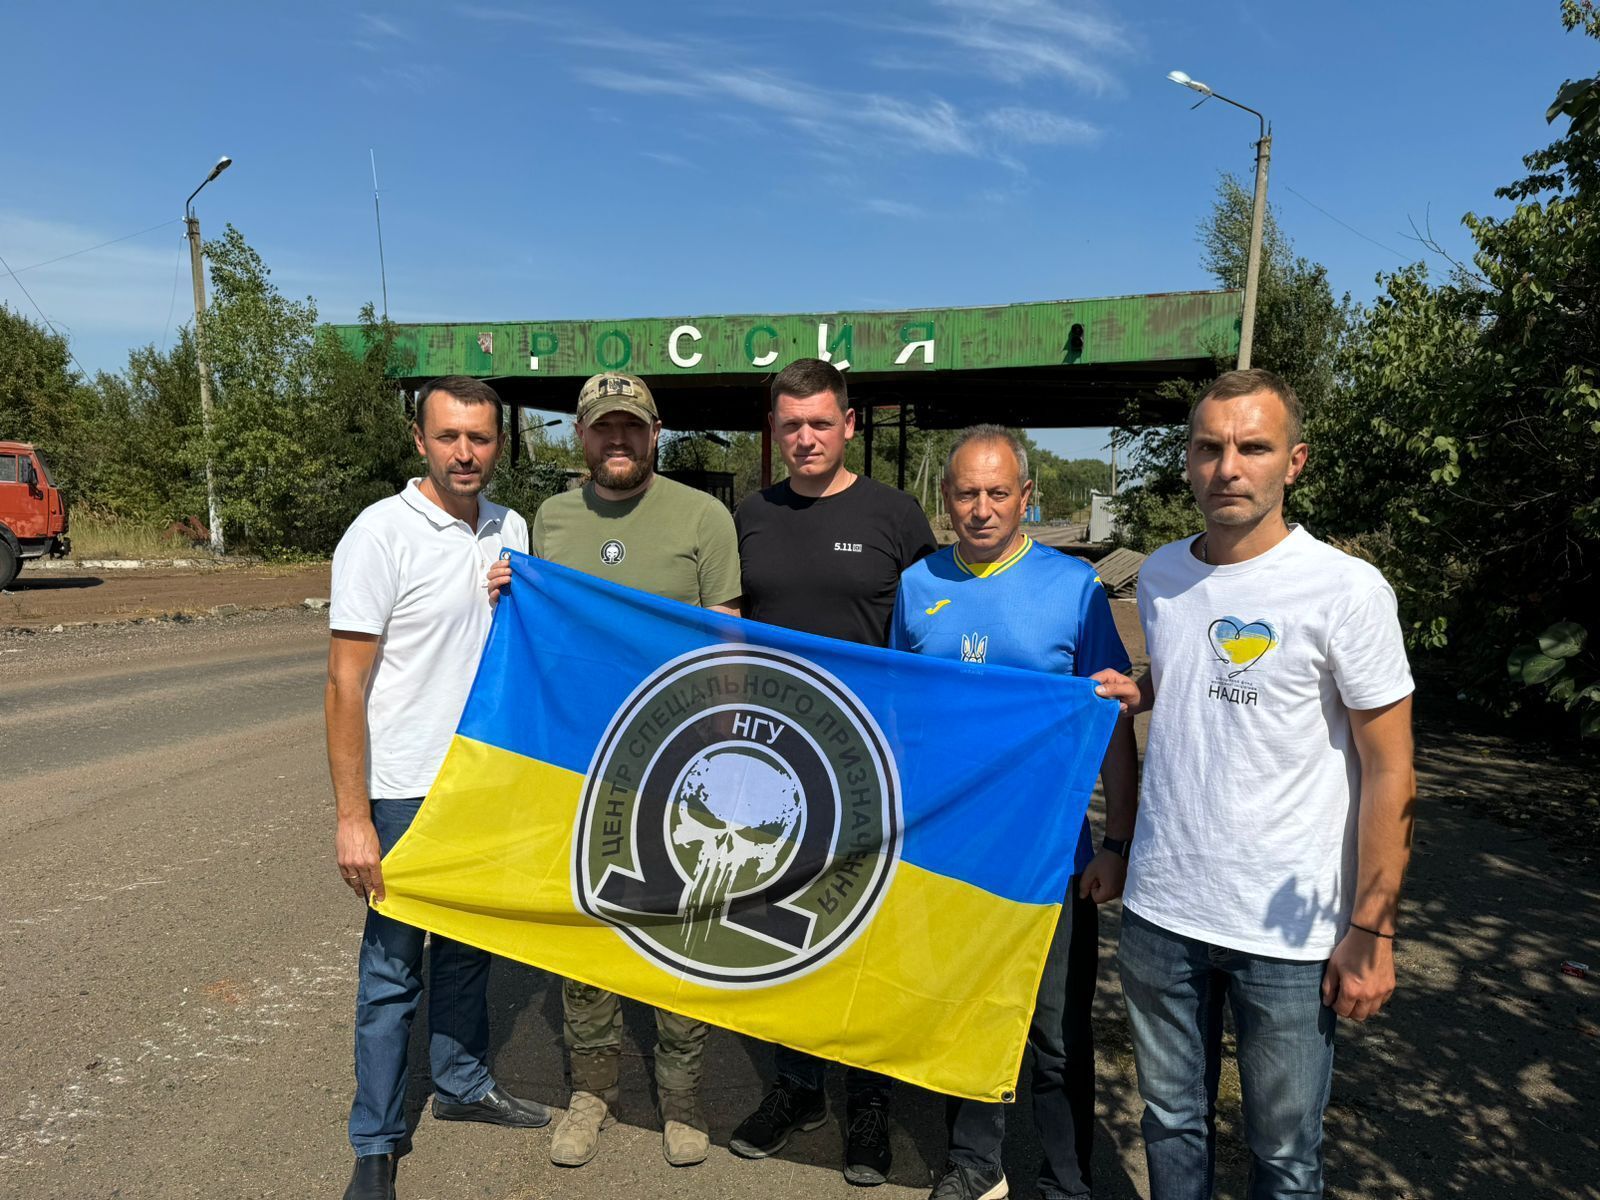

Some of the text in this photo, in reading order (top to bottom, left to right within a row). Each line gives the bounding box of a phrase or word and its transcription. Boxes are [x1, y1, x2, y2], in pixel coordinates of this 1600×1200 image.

[531, 321, 935, 371] РОССИЯ
[834, 541, 853, 552] 5.11
[1208, 684, 1258, 706] НАДІЯ
[732, 712, 786, 744] НГУ
[602, 674, 872, 916] ЦЕНТР СПЕЦІАЛЬНОГО ПРИЗНАЧЕННЯ
